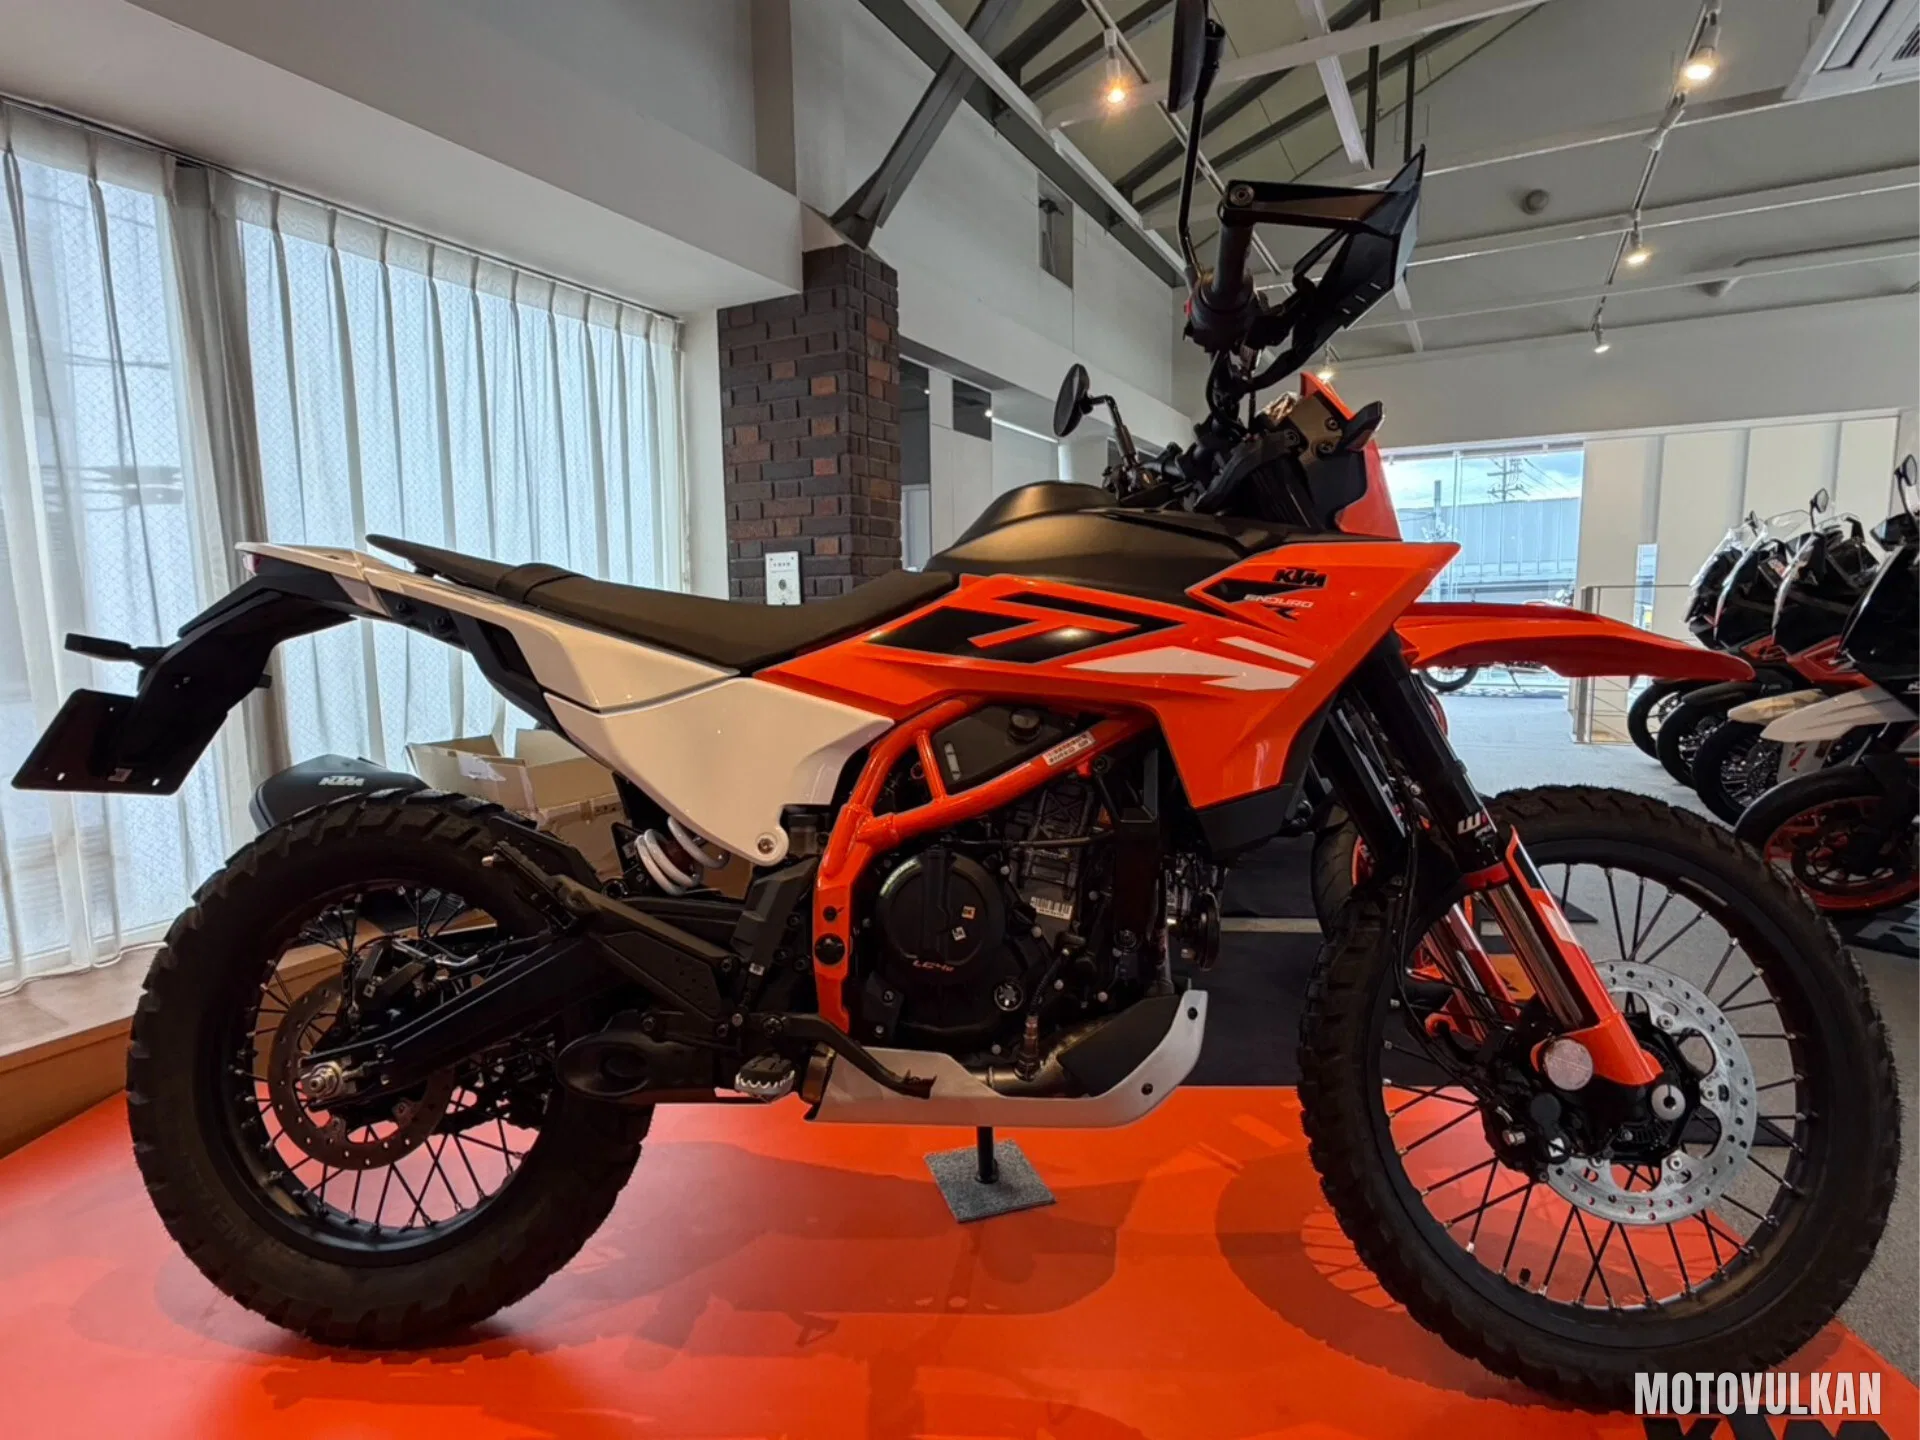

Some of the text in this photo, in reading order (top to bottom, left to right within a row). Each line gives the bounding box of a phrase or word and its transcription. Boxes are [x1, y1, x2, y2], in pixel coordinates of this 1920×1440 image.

[1273, 568, 1327, 588] KTM
[1243, 594, 1314, 609] ENDURO
[319, 776, 364, 786] KTM
